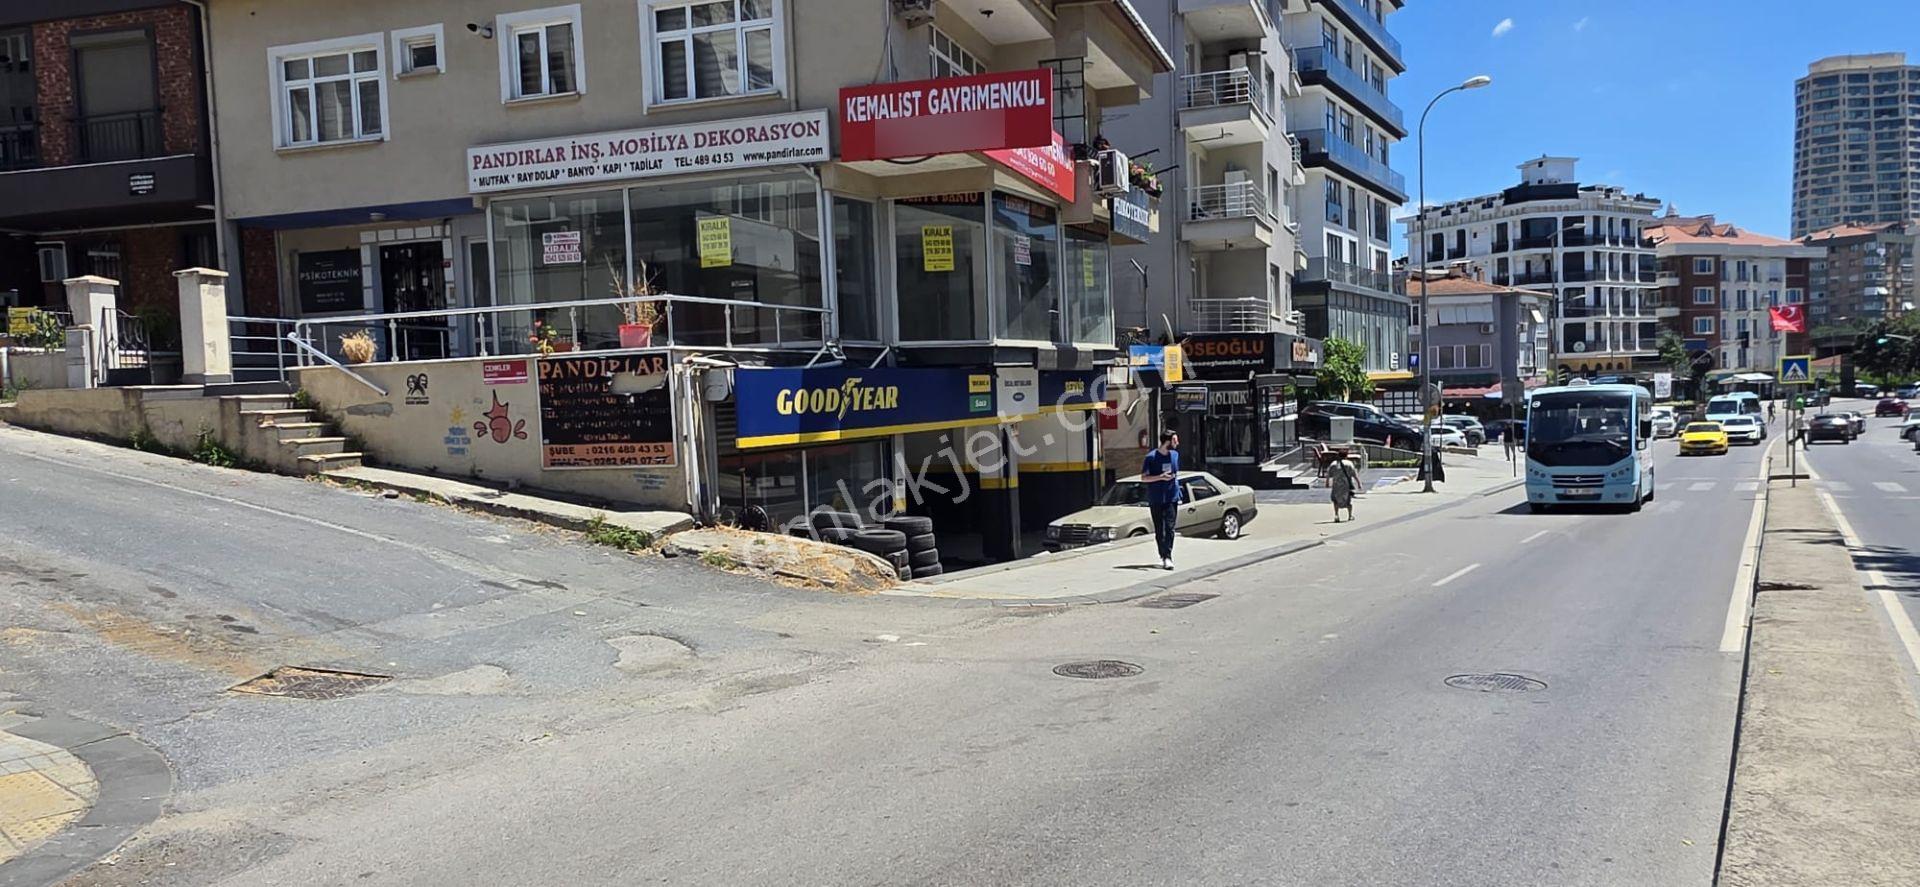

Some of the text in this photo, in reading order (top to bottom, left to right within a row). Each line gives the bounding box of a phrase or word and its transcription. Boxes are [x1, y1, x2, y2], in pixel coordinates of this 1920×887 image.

[473, 120, 821, 170] PANDIRLAR İNŞ. MOBİLYA DEKORASYON
[479, 174, 510, 187] MUTFAK
[567, 166, 595, 178] BANYO
[602, 162, 622, 174] KAPI
[630, 157, 663, 172] TADİLAT
[674, 157, 692, 168] TEL:
[694, 154, 709, 165] 489
[711, 153, 722, 164] 43
[724, 152, 734, 163] 53
[544, 245, 580, 253] KIRALIK
[776, 385, 898, 415] GOODYEAR
[639, 445, 651, 453] 43
[654, 445, 665, 453] 53
